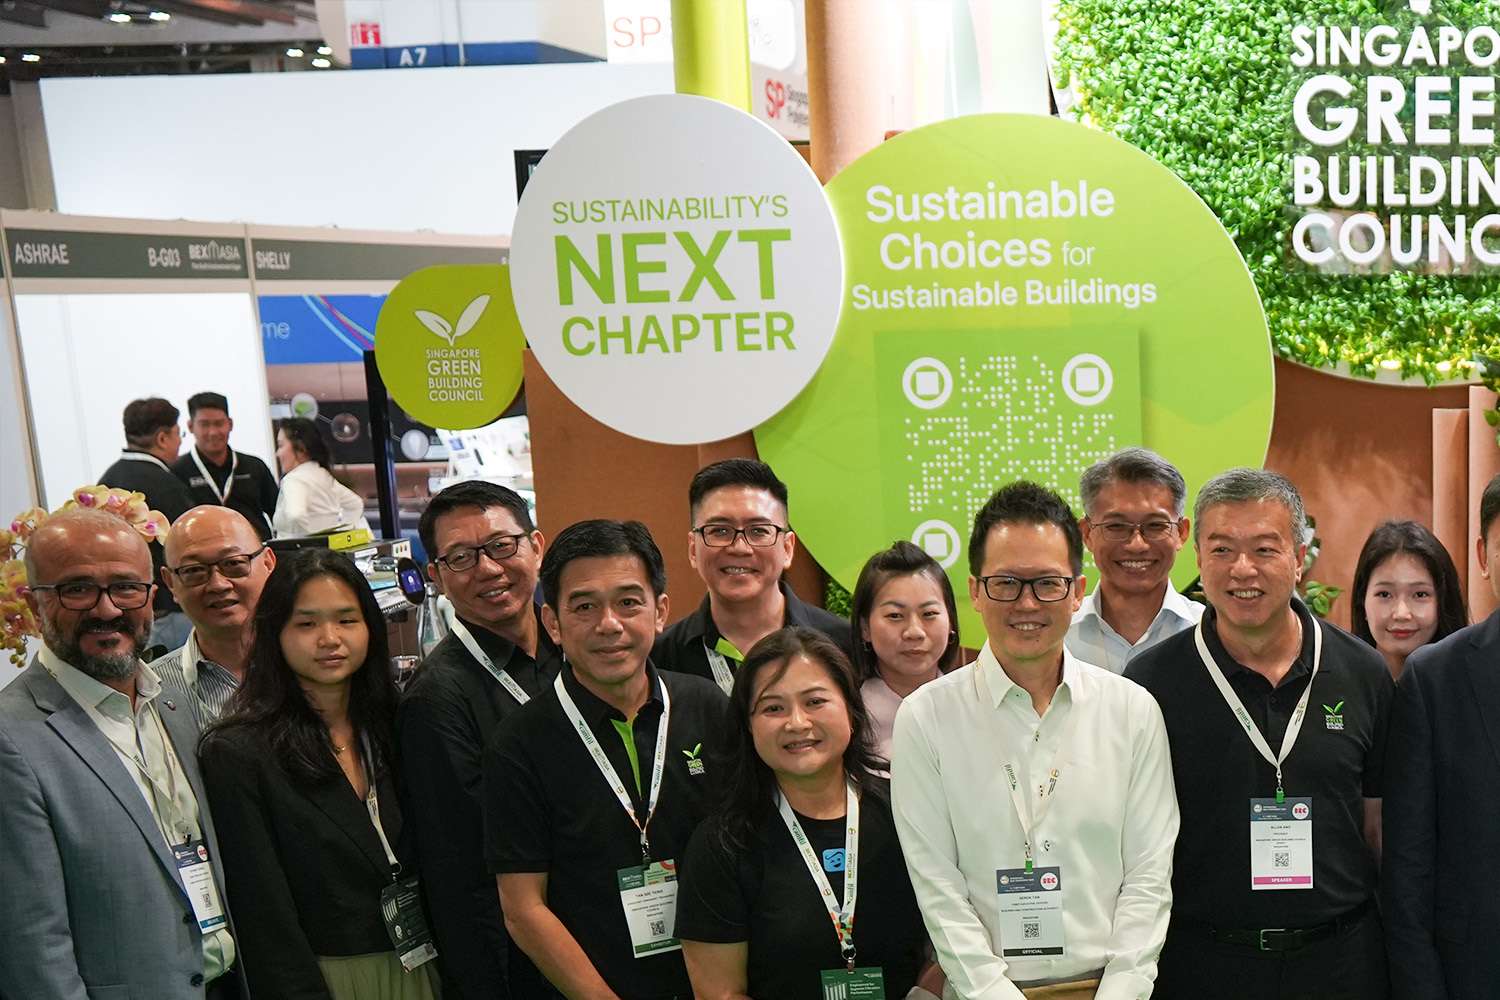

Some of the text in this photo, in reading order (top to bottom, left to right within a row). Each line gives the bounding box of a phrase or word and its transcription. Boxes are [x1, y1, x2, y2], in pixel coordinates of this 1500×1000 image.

[613, 17, 661, 47] SP
[552, 195, 789, 224] SUSTAINABILITY'S
[866, 180, 1115, 223] Sustainable
[15, 243, 70, 265] ASHRAE
[256, 250, 291, 270] SHELLY
[879, 231, 1095, 270] Choices for
[554, 228, 791, 306] NEXT
[852, 278, 1158, 310] Sustainable Buildings
[561, 311, 797, 356] CHAPTER
[426, 349, 479, 358] SINGAPORE
[427, 360, 481, 375] GREEN
[428, 377, 482, 389] BUILDING
[429, 390, 484, 402] COUNCIL
